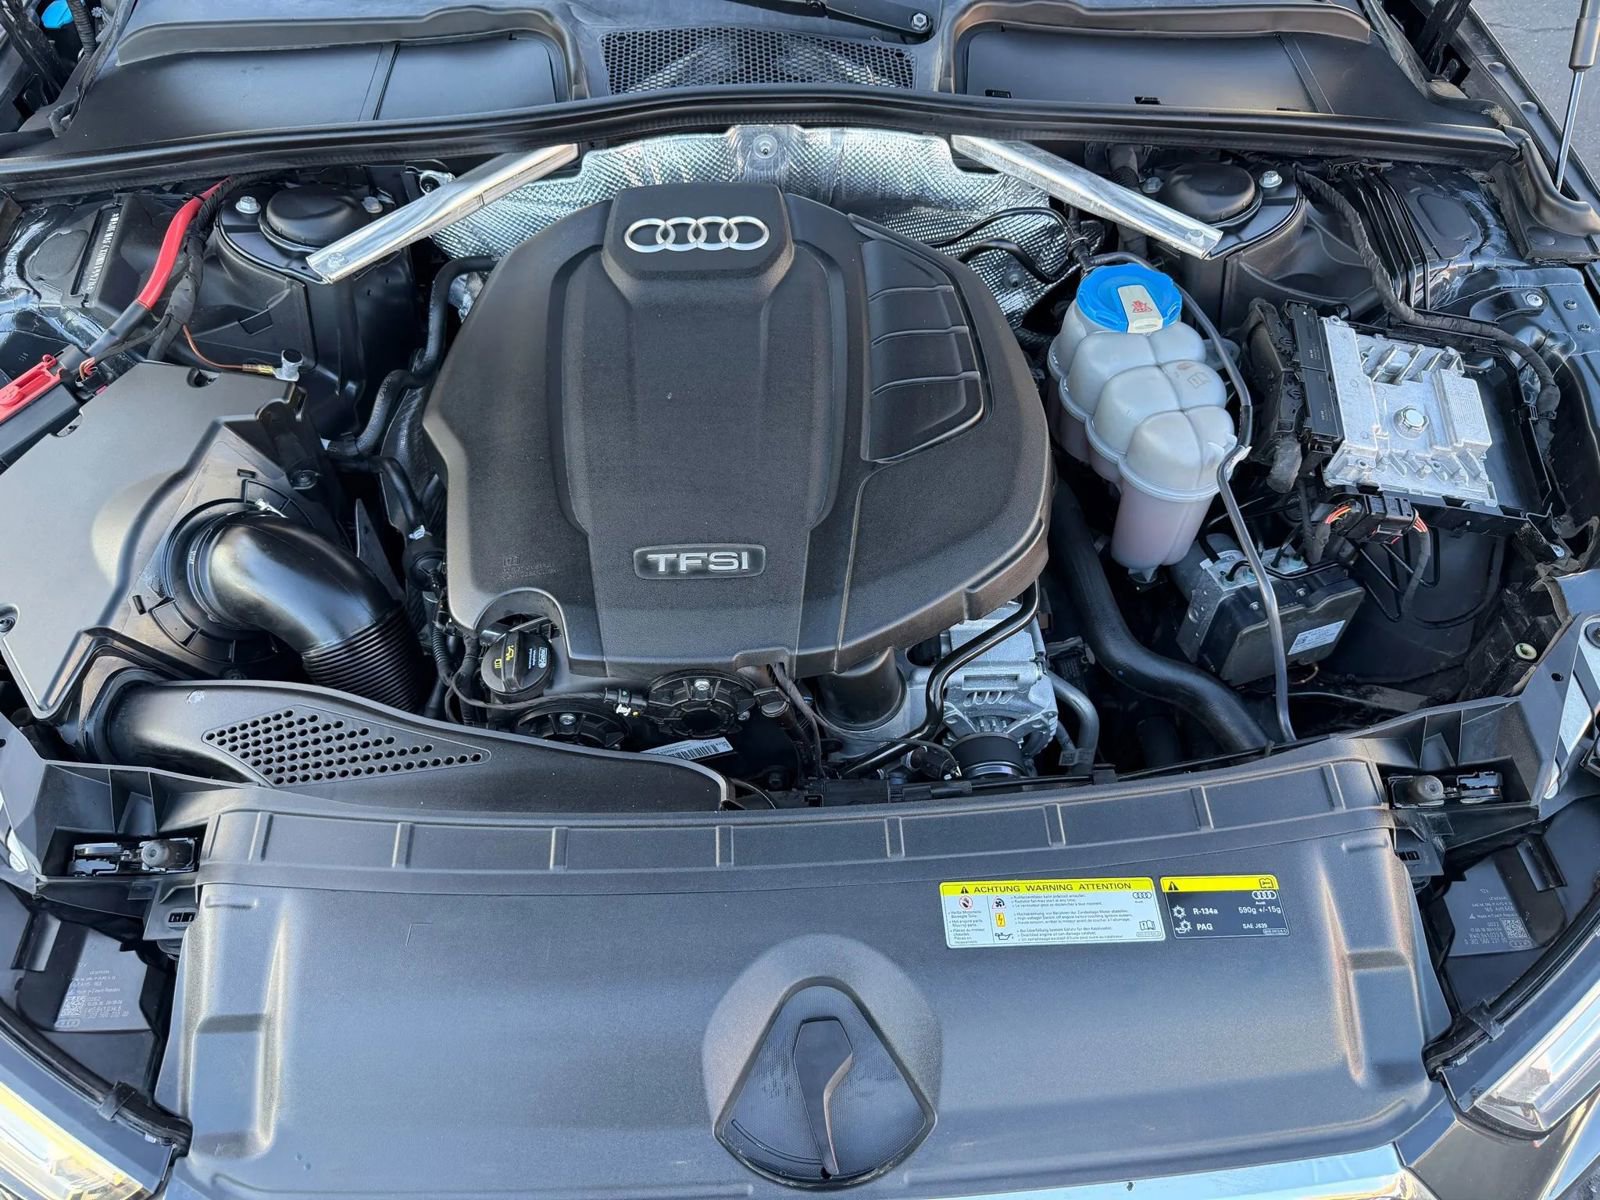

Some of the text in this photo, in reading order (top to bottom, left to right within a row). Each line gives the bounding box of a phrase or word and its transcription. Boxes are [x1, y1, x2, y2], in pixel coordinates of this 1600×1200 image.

[646, 551, 749, 574] TFSI
[973, 882, 1132, 894] ACHTUNG WARNING ATTENTION
[1192, 905, 1282, 915] R-134a 590g +/-15g
[1196, 923, 1214, 931] PAG
